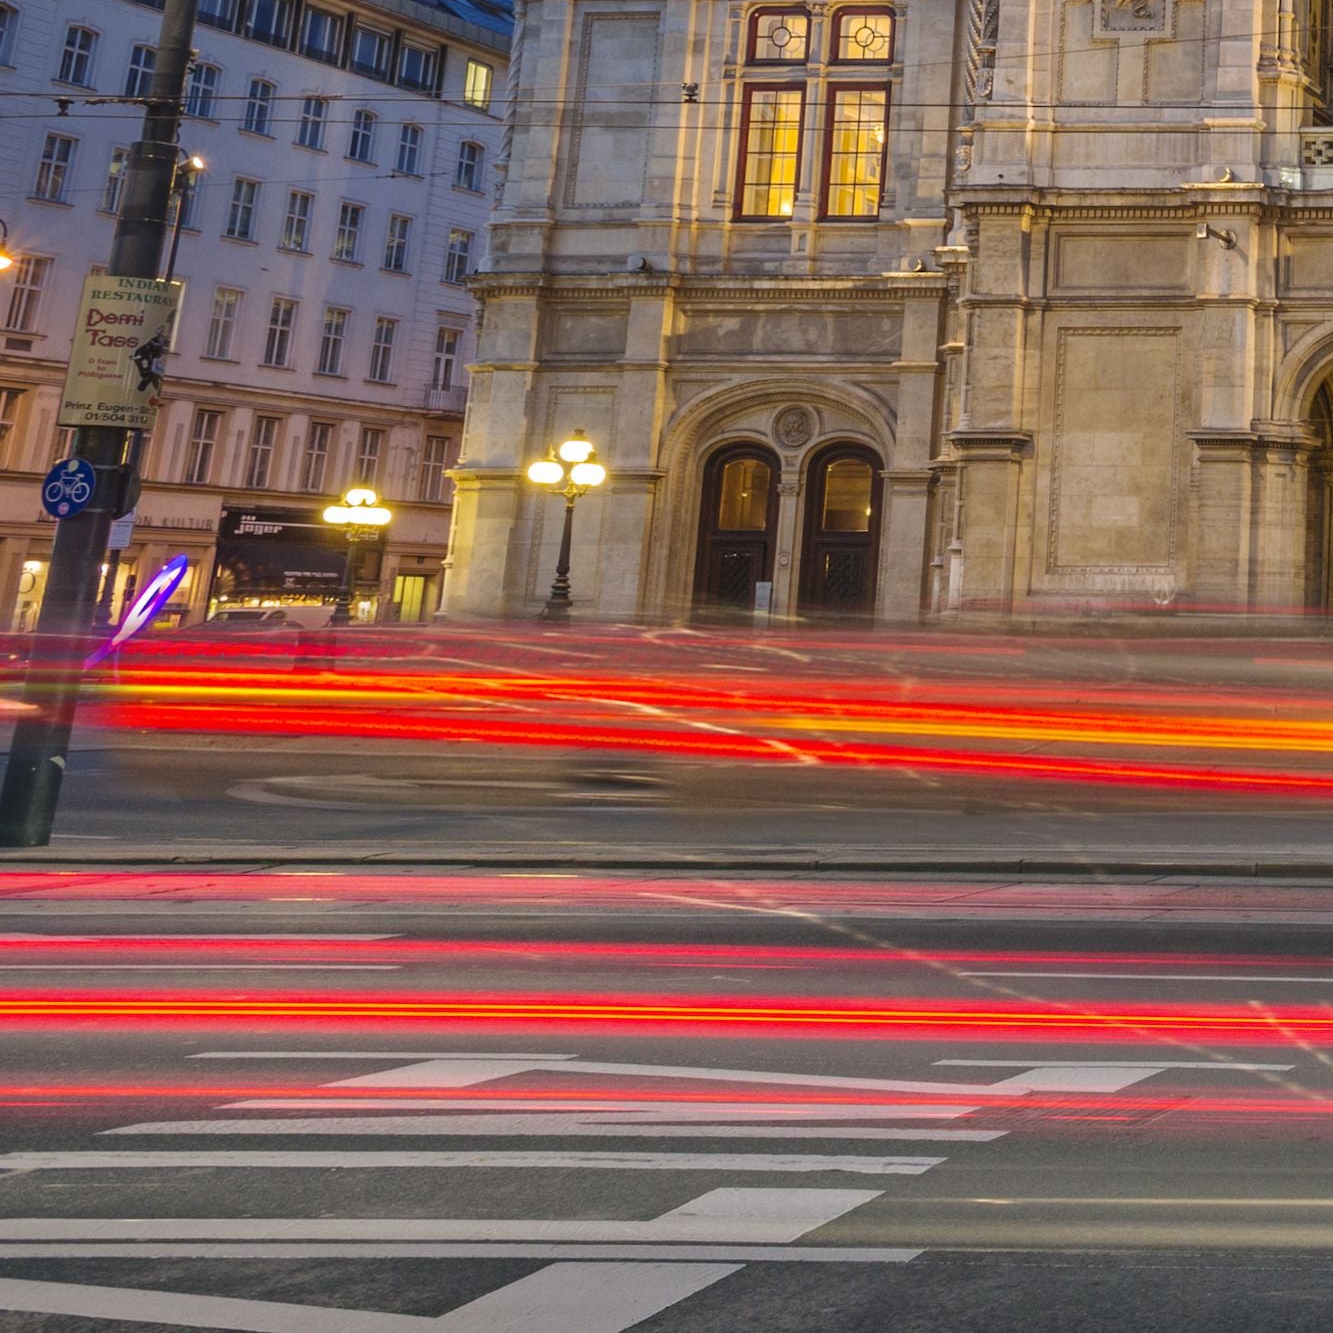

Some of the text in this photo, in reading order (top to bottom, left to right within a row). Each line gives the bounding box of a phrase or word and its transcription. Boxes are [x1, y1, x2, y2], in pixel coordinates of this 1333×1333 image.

[86, 308, 145, 327] Demi
[86, 329, 139, 348] Tass
[65, 401, 92, 411] Prinz
[162, 516, 213, 530] KULTUR
